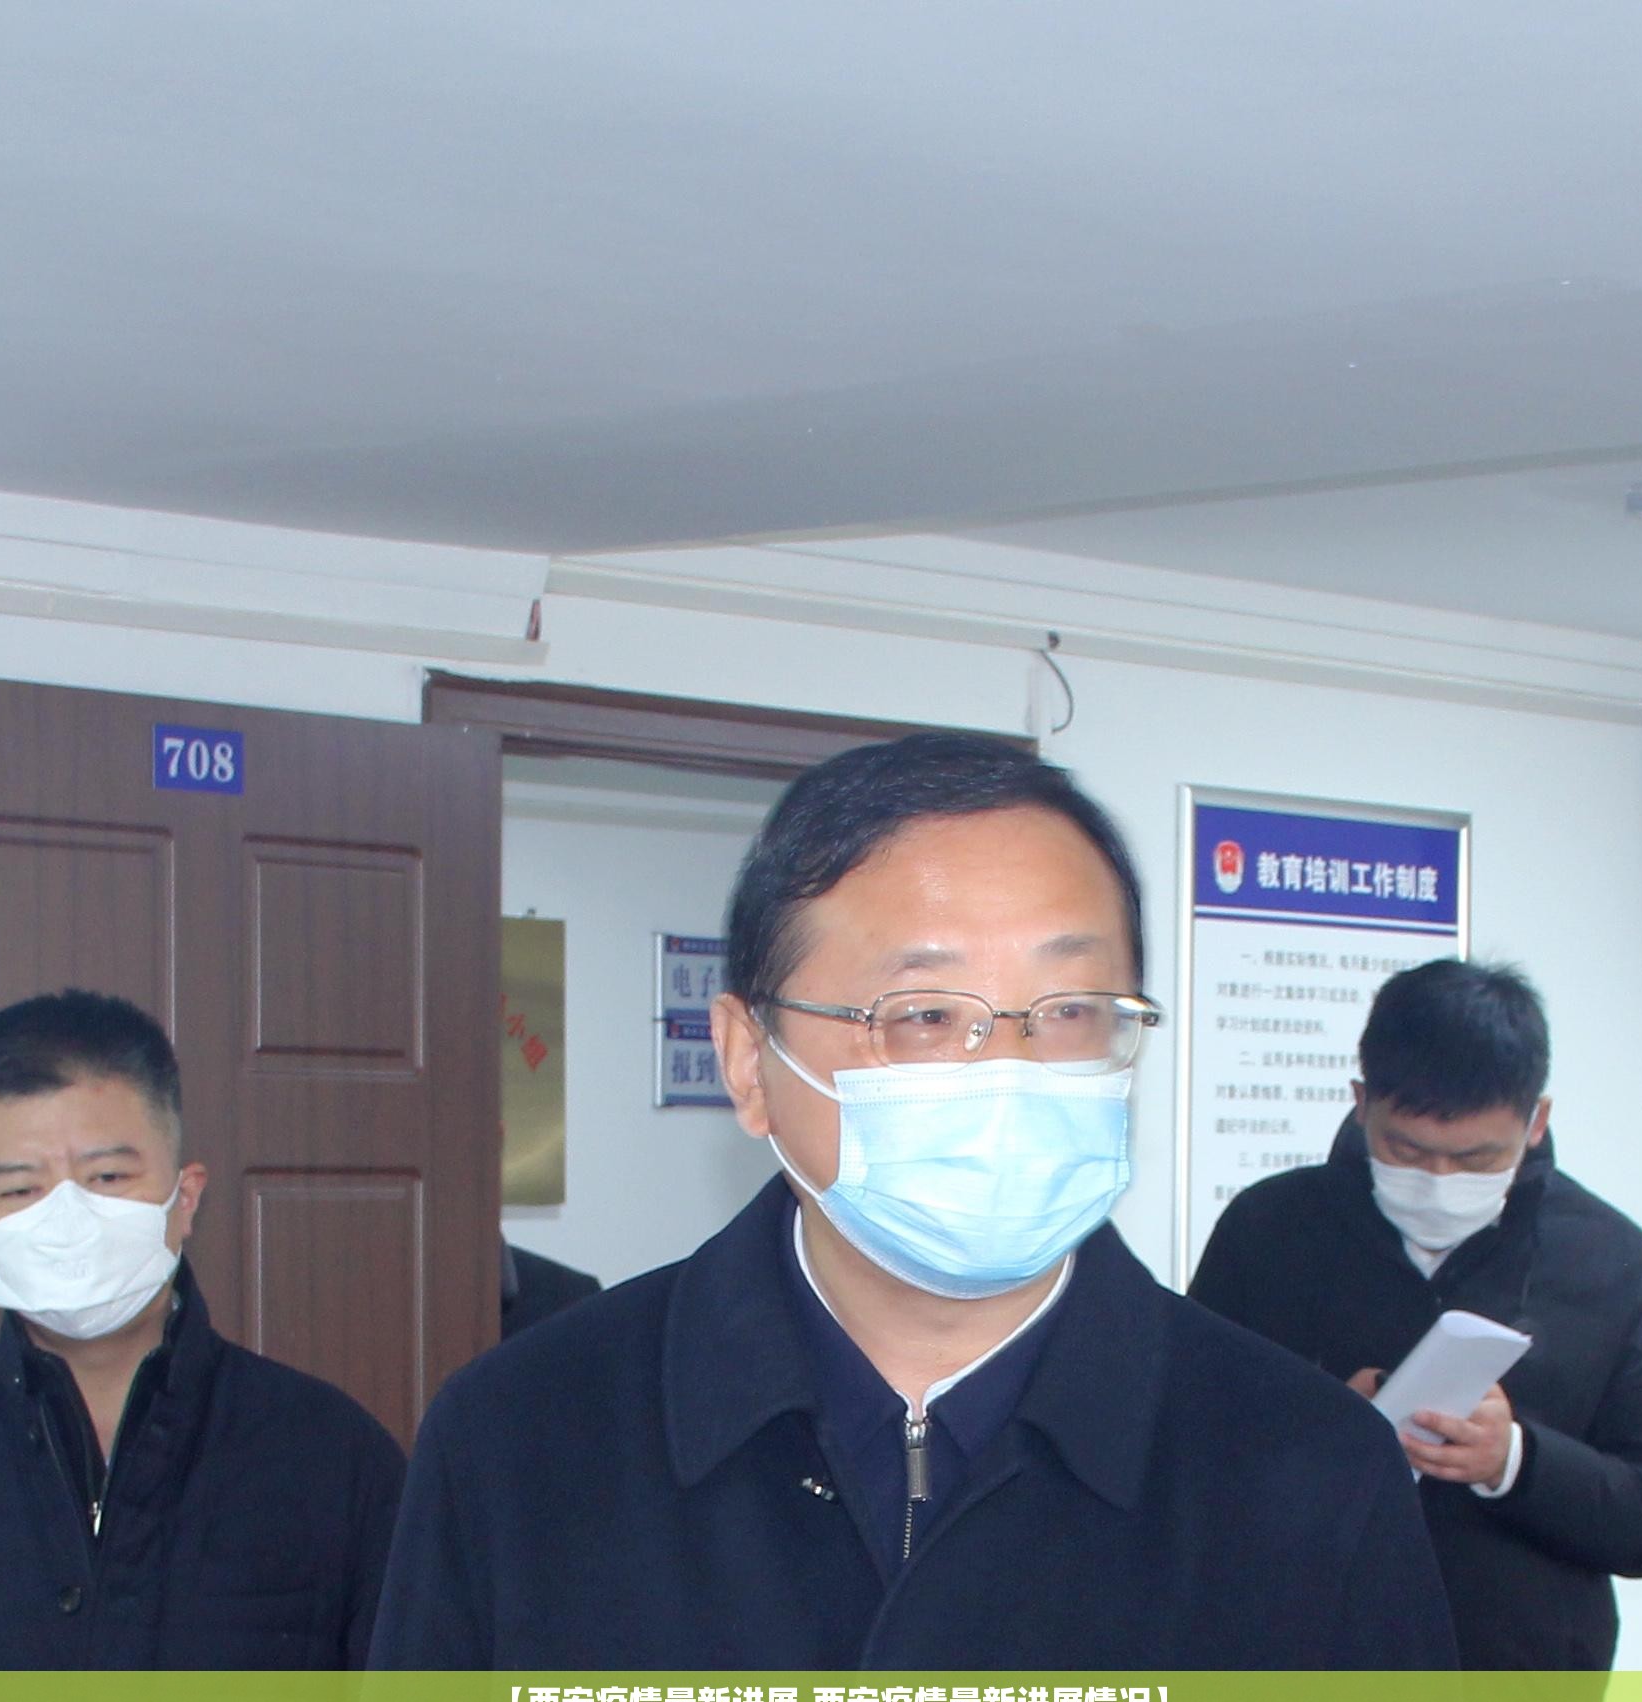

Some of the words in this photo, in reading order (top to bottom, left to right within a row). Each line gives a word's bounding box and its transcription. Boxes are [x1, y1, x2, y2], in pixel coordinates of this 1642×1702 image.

[163, 737, 235, 783] 708
[1257, 851, 1439, 902] 教育培训工作制度
